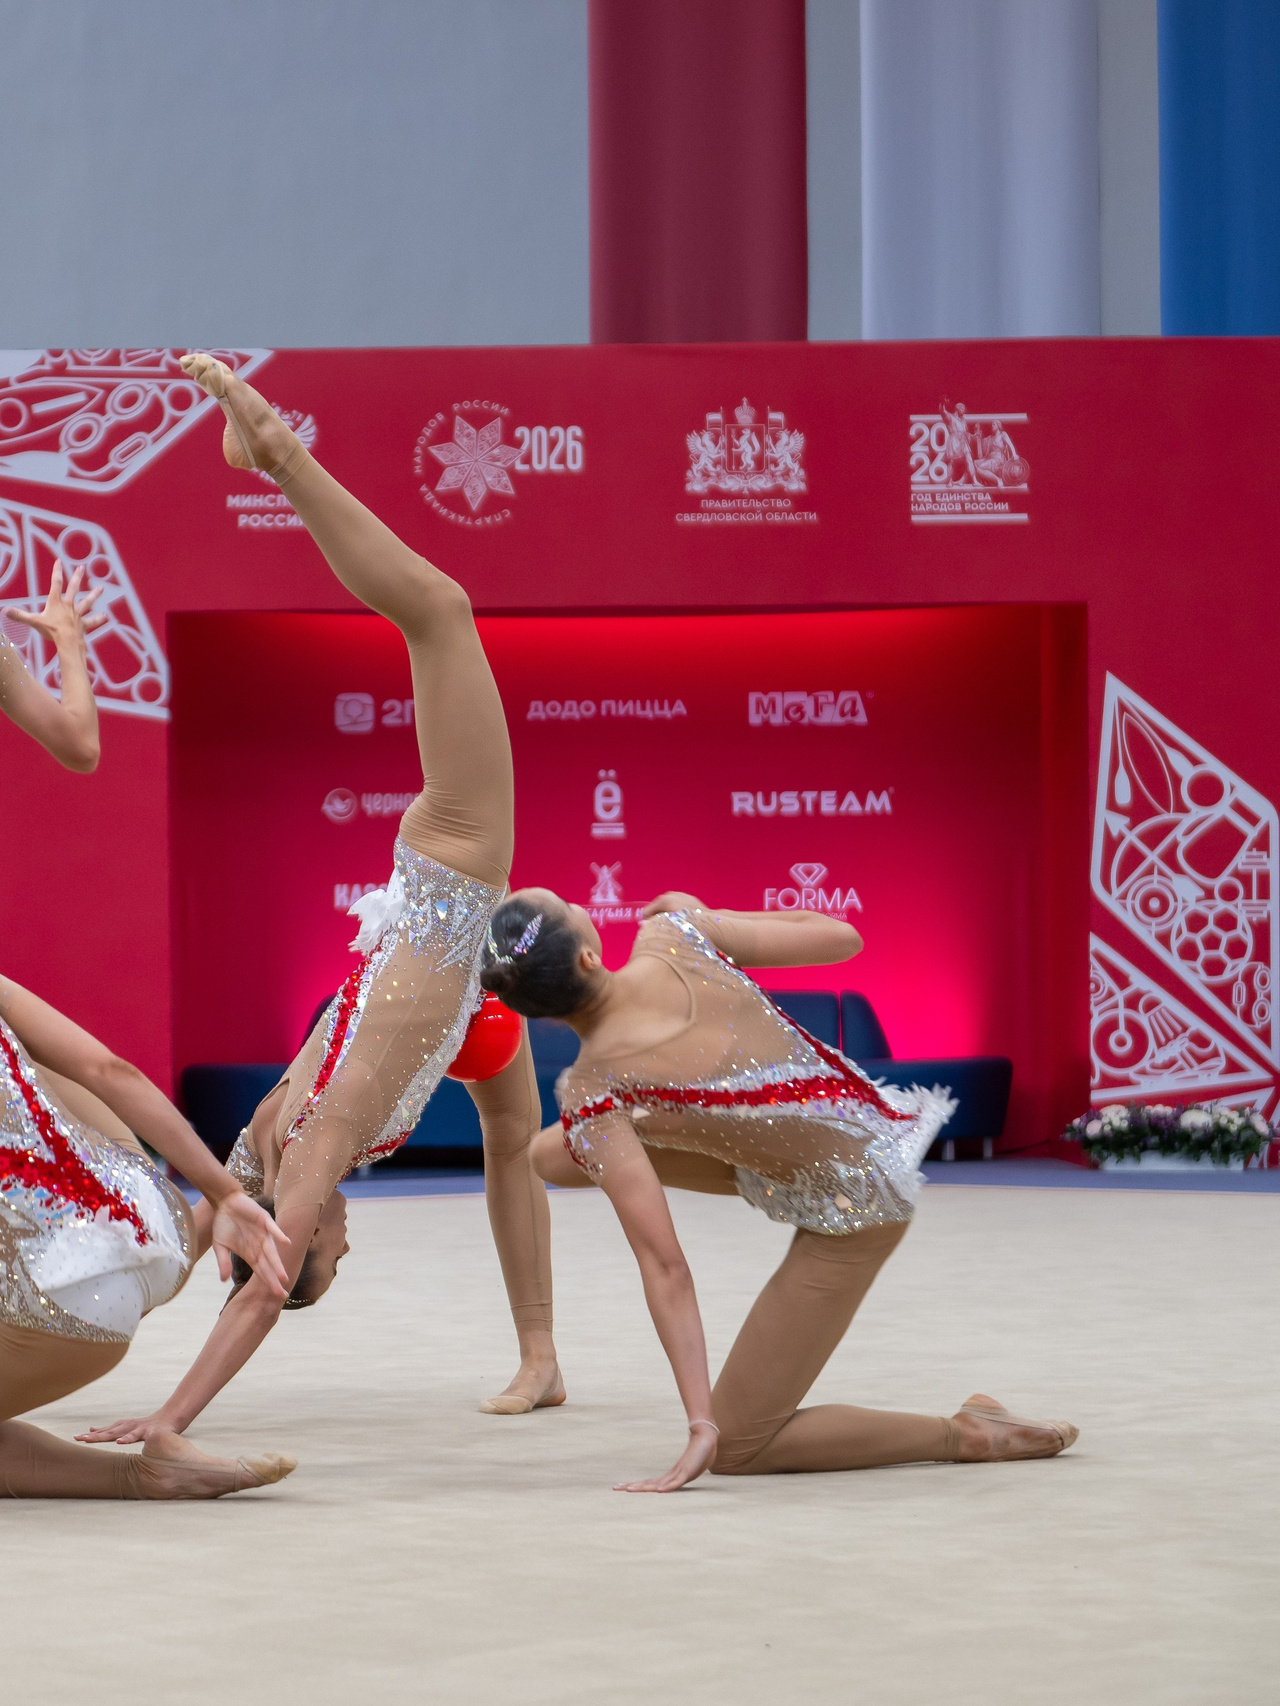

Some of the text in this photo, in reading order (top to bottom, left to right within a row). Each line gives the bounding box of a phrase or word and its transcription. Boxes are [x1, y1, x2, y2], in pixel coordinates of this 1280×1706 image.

[414, 400, 509, 473] НАРОДОВ РОССИИ
[910, 422, 949, 452] 20
[514, 426, 583, 470] 2026
[910, 452, 948, 482] 26
[420, 484, 511, 525] СПАРТАКИАДА
[701, 499, 791, 508] ПРАВИТЕЛЬСТВО
[911, 492, 992, 502] ГОД ЕДИНСТВА
[911, 502, 1009, 512] НАРОДОВ РОССИИ
[676, 510, 817, 522] СВЕРДЛОВСКОЙ ОБЛАСТИ
[526, 699, 687, 719] ДОДО ПИЦЦА
[731, 790, 891, 813] RUSTEAM
[765, 887, 862, 909] FORMA
